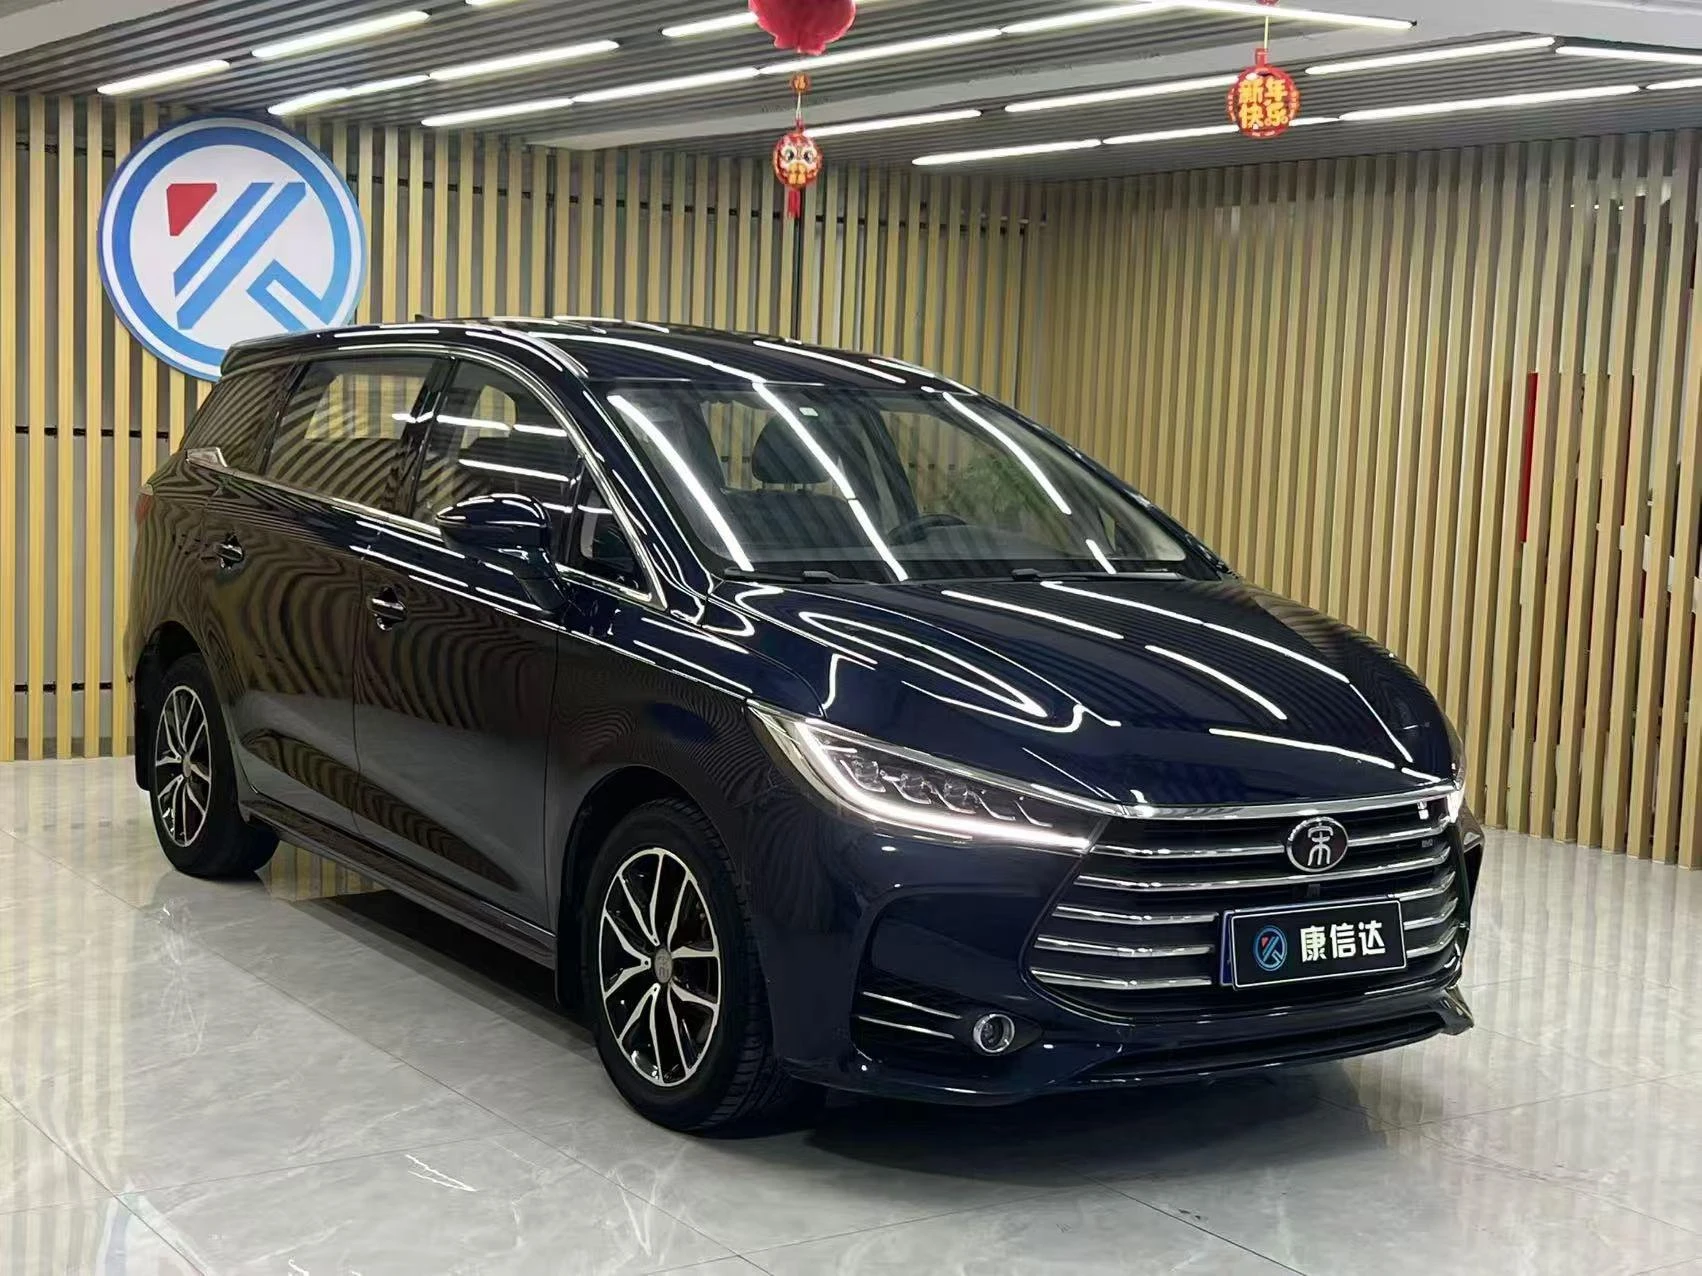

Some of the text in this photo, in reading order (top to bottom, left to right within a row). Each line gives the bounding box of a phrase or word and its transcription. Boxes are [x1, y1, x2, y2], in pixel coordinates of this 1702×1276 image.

[1239, 76, 1287, 103] 新年
[1239, 101, 1289, 129] 快乐
[1300, 920, 1386, 962] 康信达
